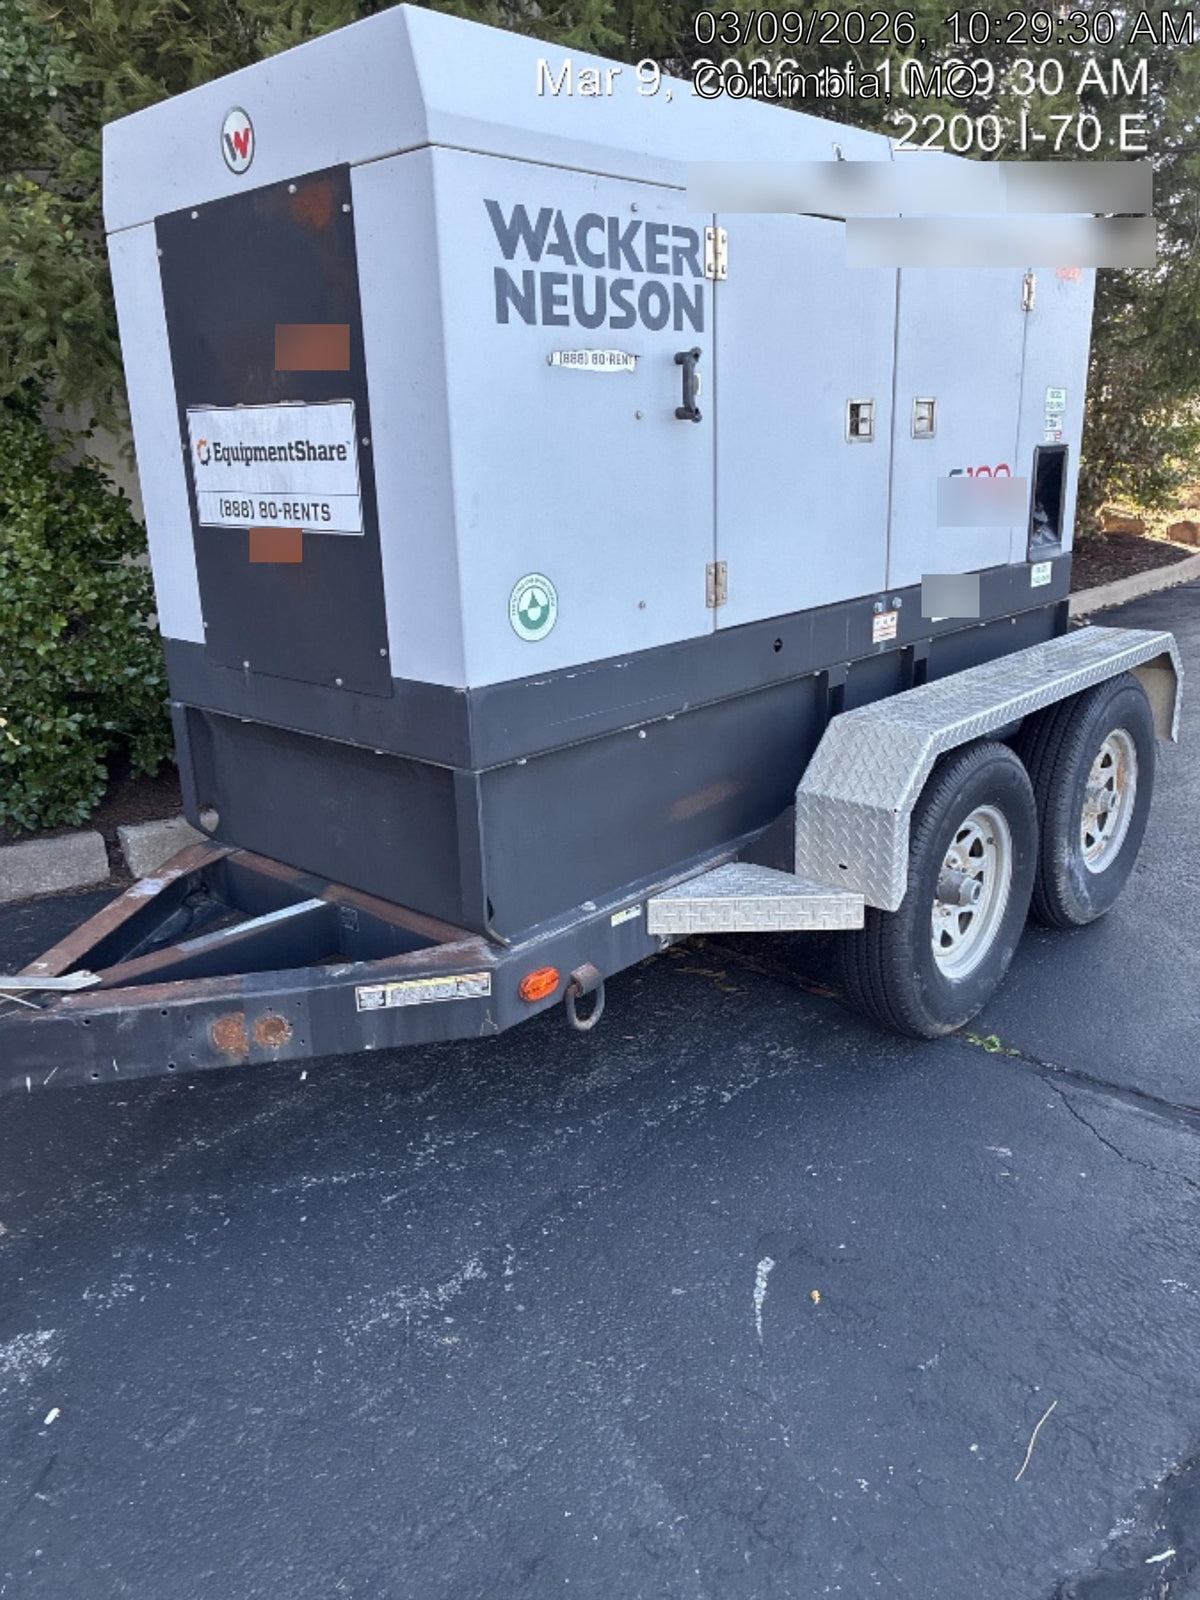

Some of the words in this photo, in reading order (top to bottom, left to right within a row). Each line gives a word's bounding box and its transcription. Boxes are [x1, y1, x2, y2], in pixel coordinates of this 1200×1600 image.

[483, 199, 704, 277] WACKER
[494, 266, 704, 333] NEUSON
[212, 440, 348, 467] EquipmentShare
[219, 498, 255, 519] (888)
[258, 500, 332, 522] 80-RENTS
